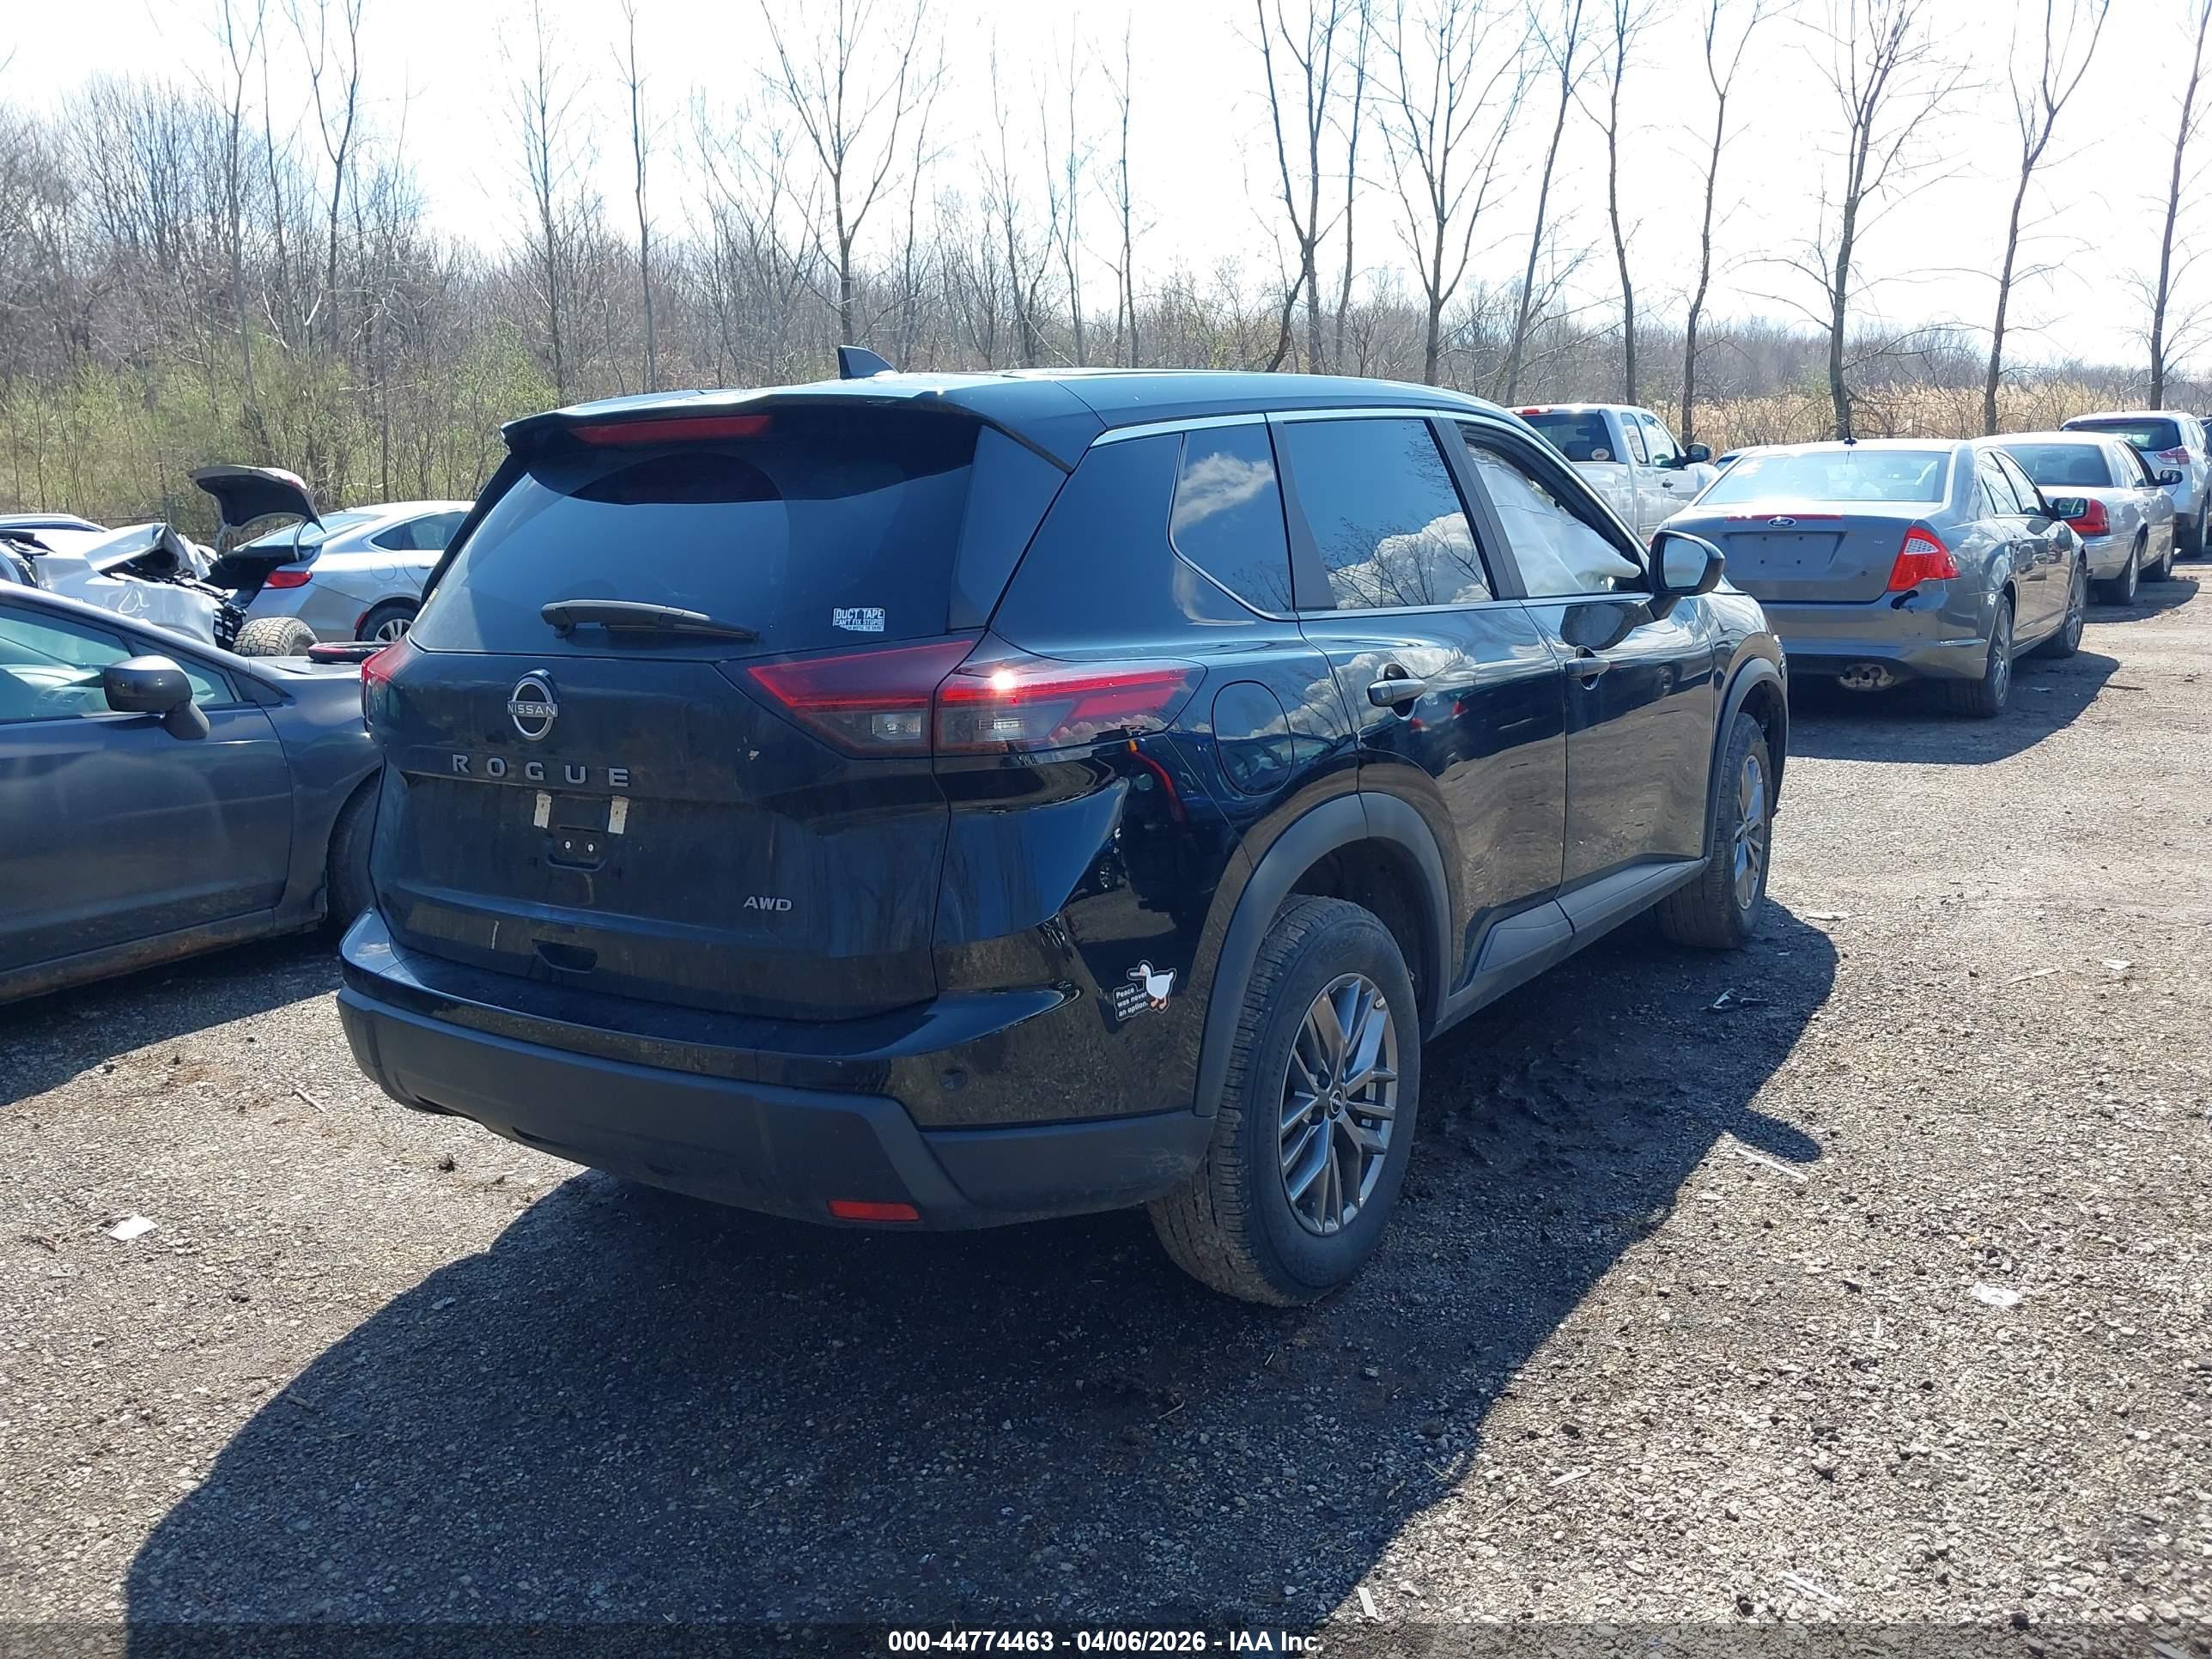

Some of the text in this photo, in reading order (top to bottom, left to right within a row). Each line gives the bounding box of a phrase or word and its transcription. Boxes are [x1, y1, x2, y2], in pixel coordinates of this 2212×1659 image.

[836, 609, 883, 618] DUCT TAPE
[507, 703, 556, 715] NISSAN
[452, 754, 629, 787] ROGUE
[744, 896, 792, 911] AWD
[1116, 988, 1134, 1000] Peace
[1117, 991, 1147, 1008] was never
[1127, 1000, 1149, 1013] option.
